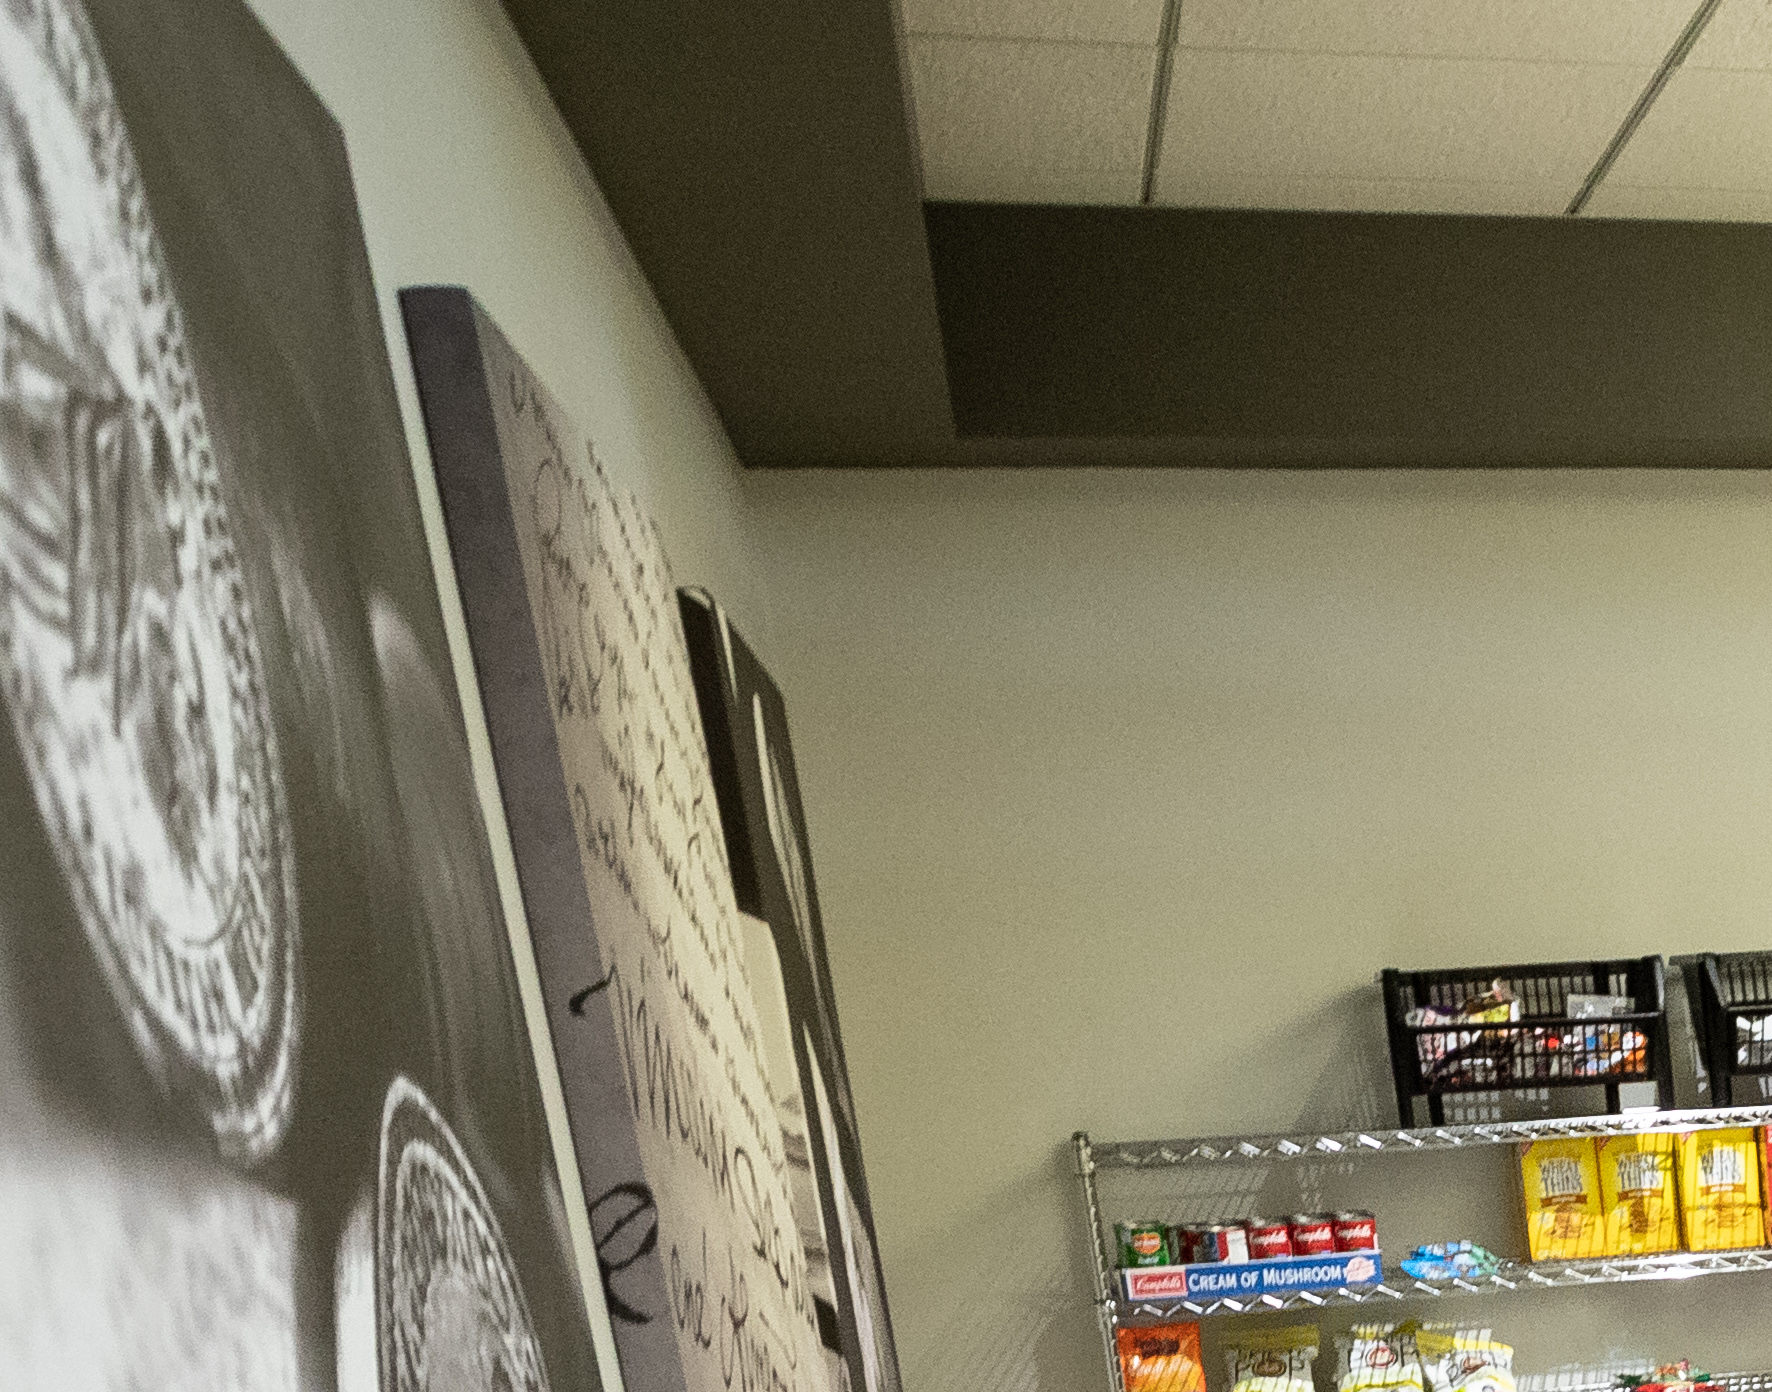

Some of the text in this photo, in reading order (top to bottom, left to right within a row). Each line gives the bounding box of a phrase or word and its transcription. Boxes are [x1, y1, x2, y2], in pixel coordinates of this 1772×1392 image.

[1188, 1264, 1342, 1293] CREAM OF MUSHROOM
